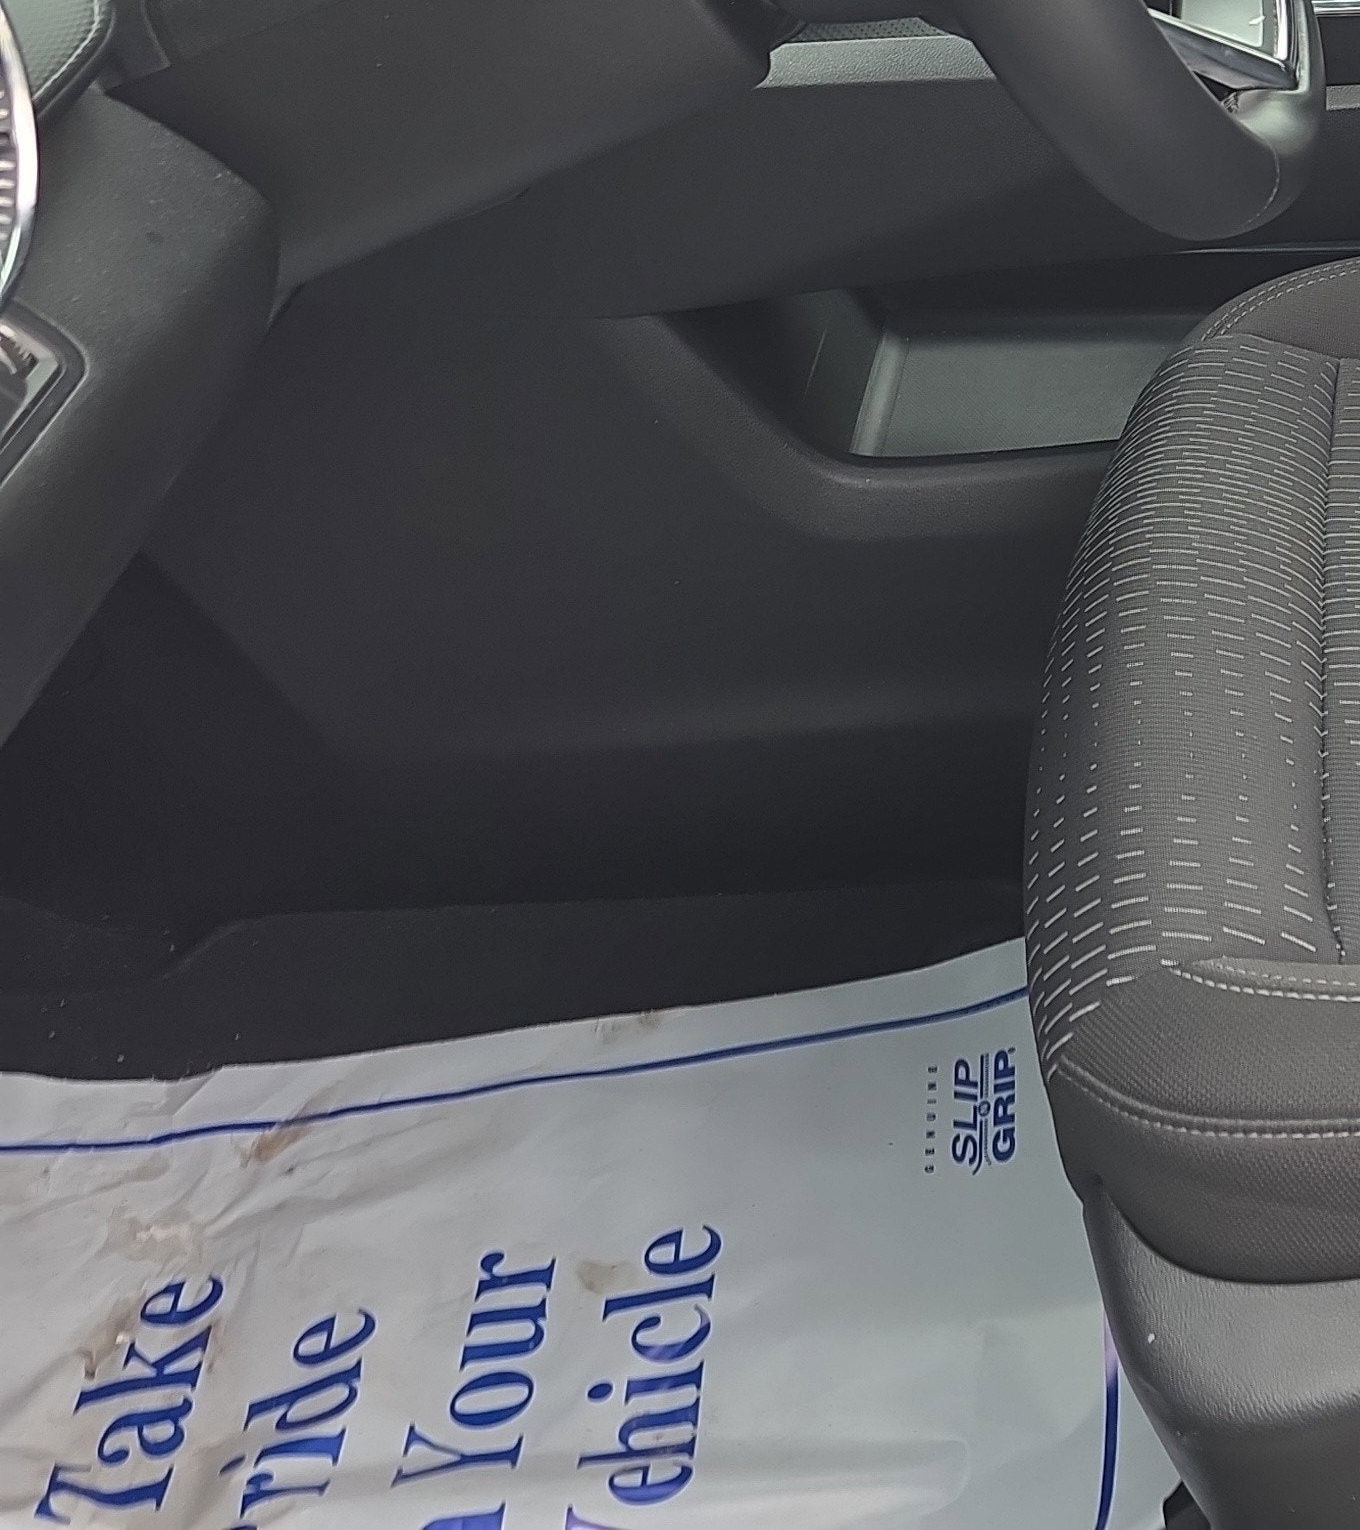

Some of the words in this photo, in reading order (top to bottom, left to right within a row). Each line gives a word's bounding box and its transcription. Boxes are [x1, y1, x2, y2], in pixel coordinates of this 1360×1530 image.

[951, 1058, 979, 1166] SLIP
[34, 1275, 224, 1525] Take
[219, 1308, 377, 1530] ride
[390, 1249, 556, 1488] Your
[565, 1225, 722, 1530] ehicle
